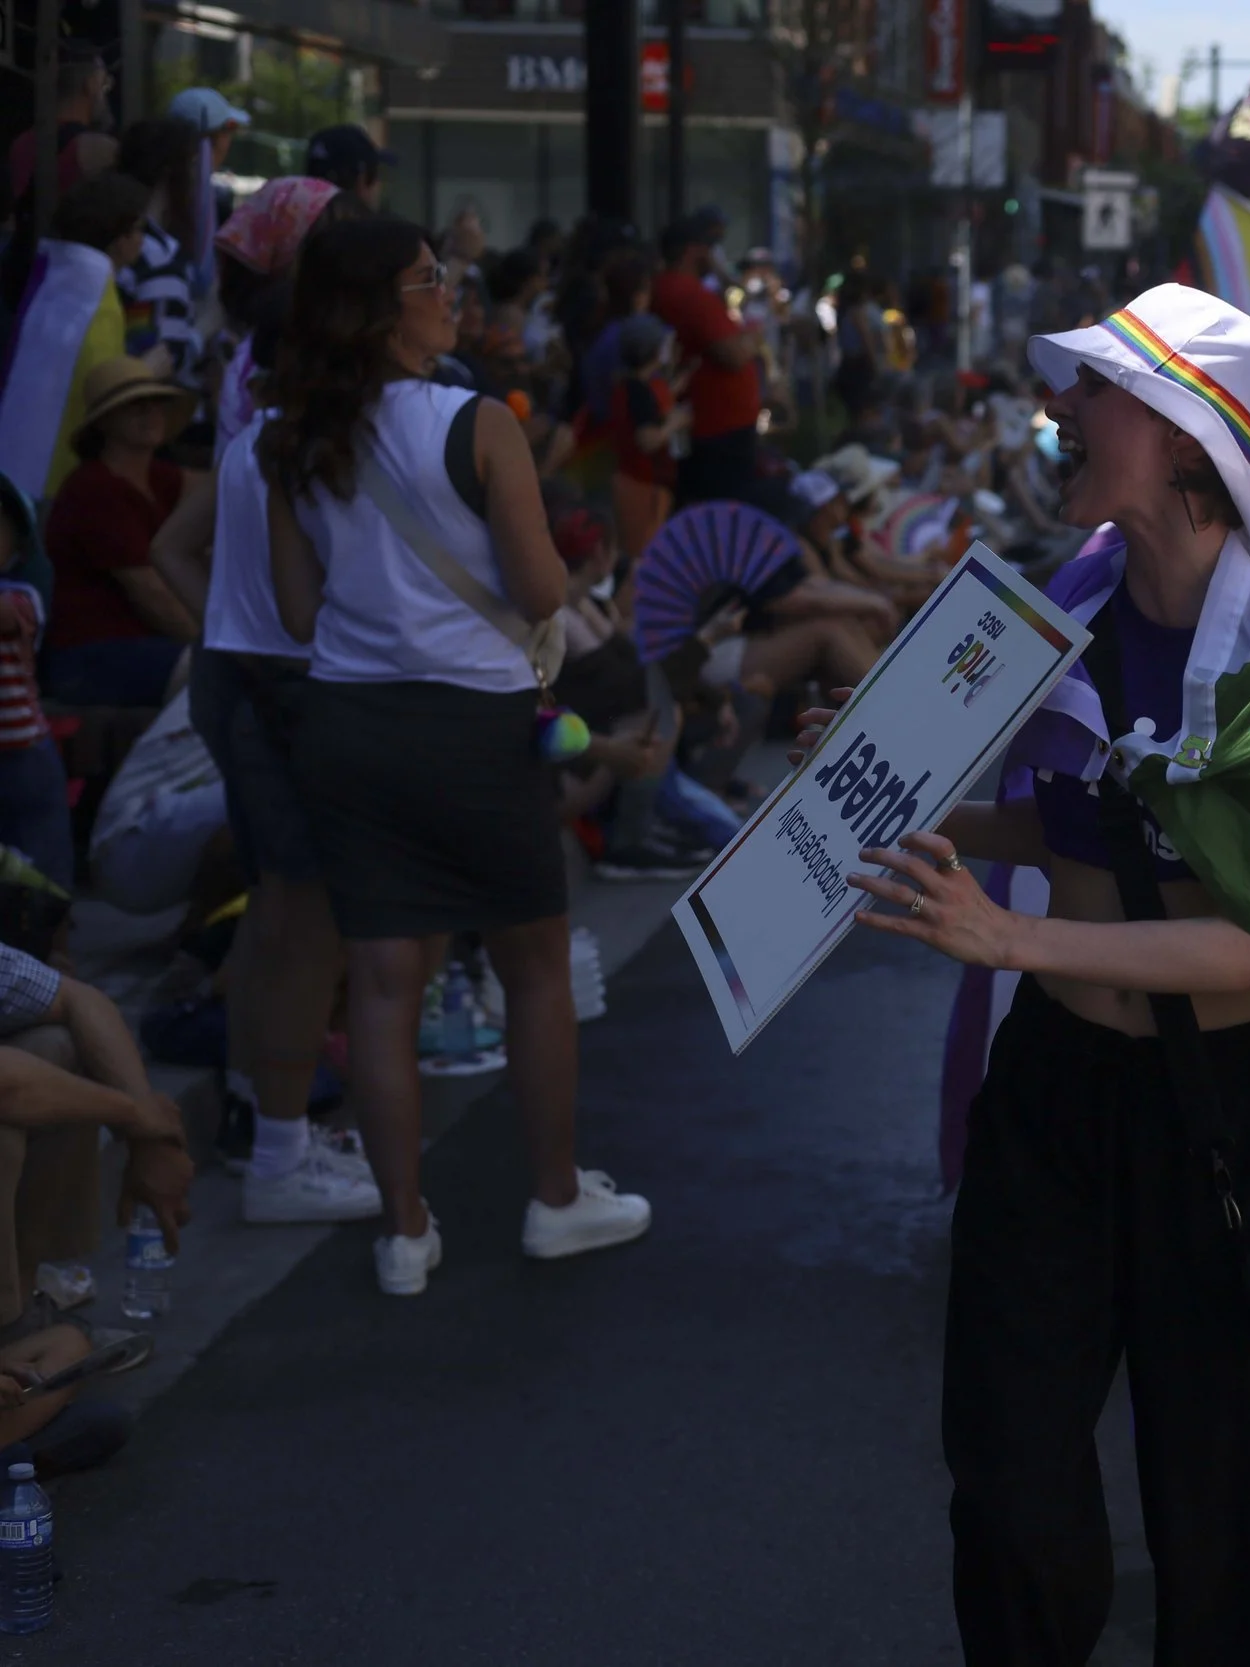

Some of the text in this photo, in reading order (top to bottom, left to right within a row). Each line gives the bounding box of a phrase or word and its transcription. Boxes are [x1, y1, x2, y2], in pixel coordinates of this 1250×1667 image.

[507, 54, 588, 91] BM
[977, 611, 1006, 640] nscc
[942, 633, 1006, 708] Pride
[815, 731, 932, 848] queer
[776, 798, 848, 919] Unapologetically
